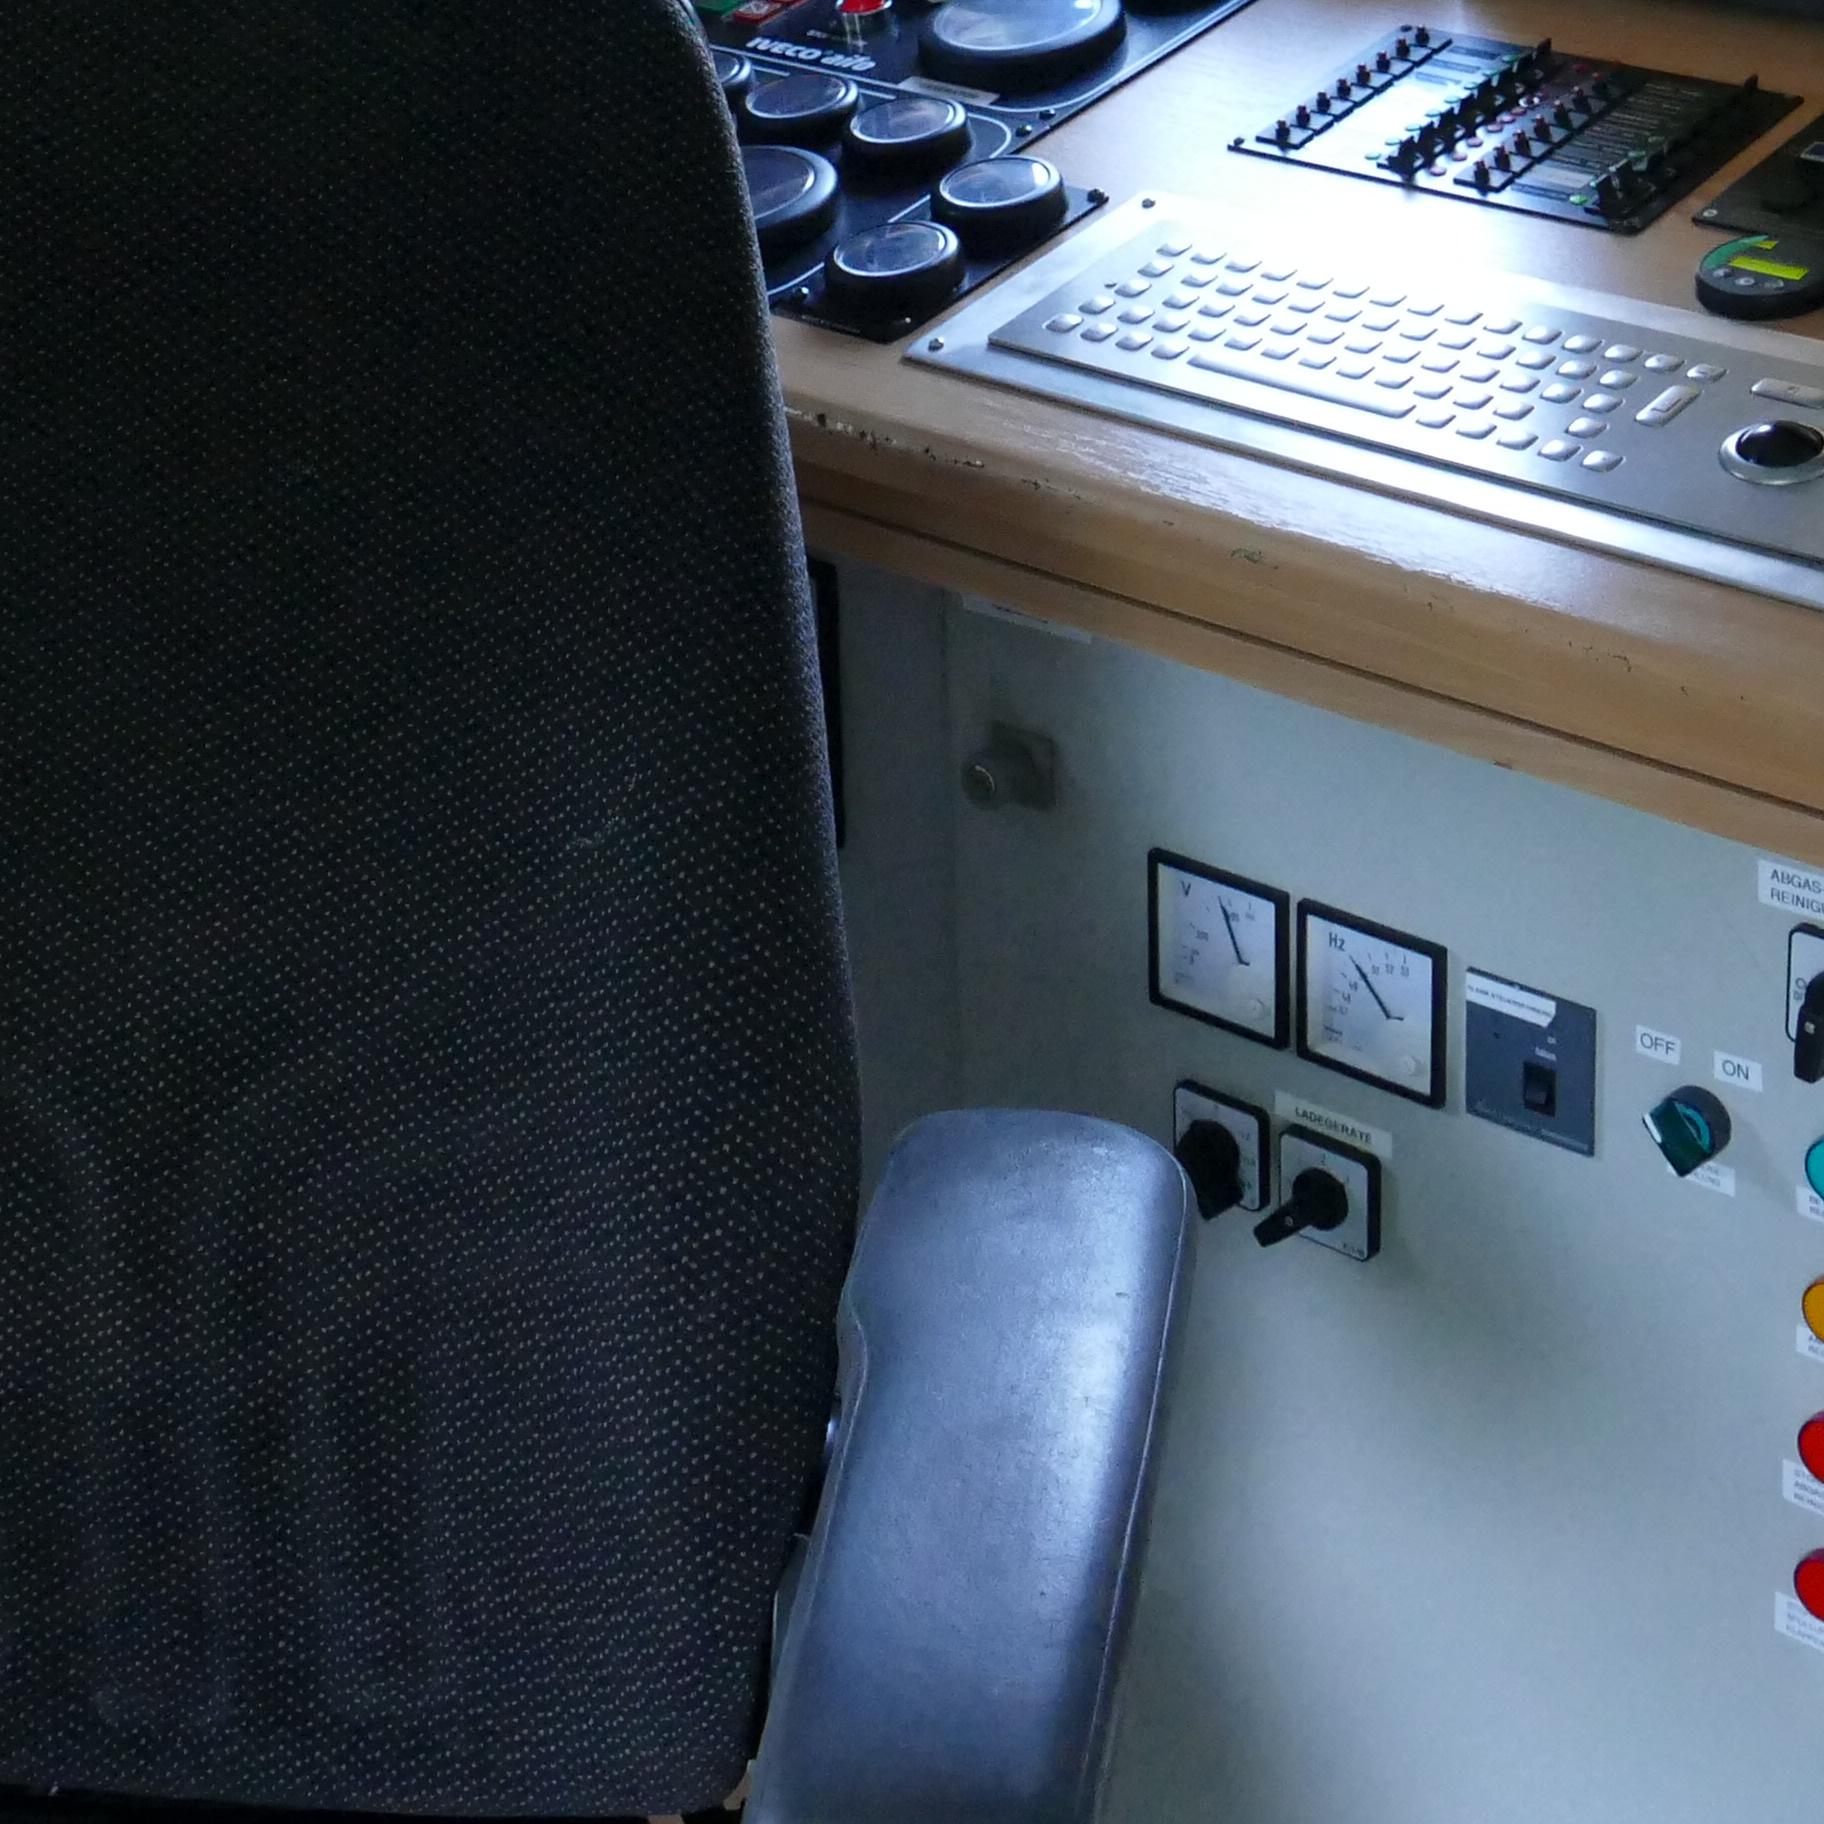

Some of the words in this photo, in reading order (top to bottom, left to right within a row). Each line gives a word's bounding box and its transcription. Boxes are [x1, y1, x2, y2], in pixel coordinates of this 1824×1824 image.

[745, 36, 822, 61] IVECO
[1181, 880, 1192, 897] V
[1328, 931, 1346, 952] Hz
[1639, 1032, 1676, 1056] OFF
[1721, 1060, 1750, 1081] ON
